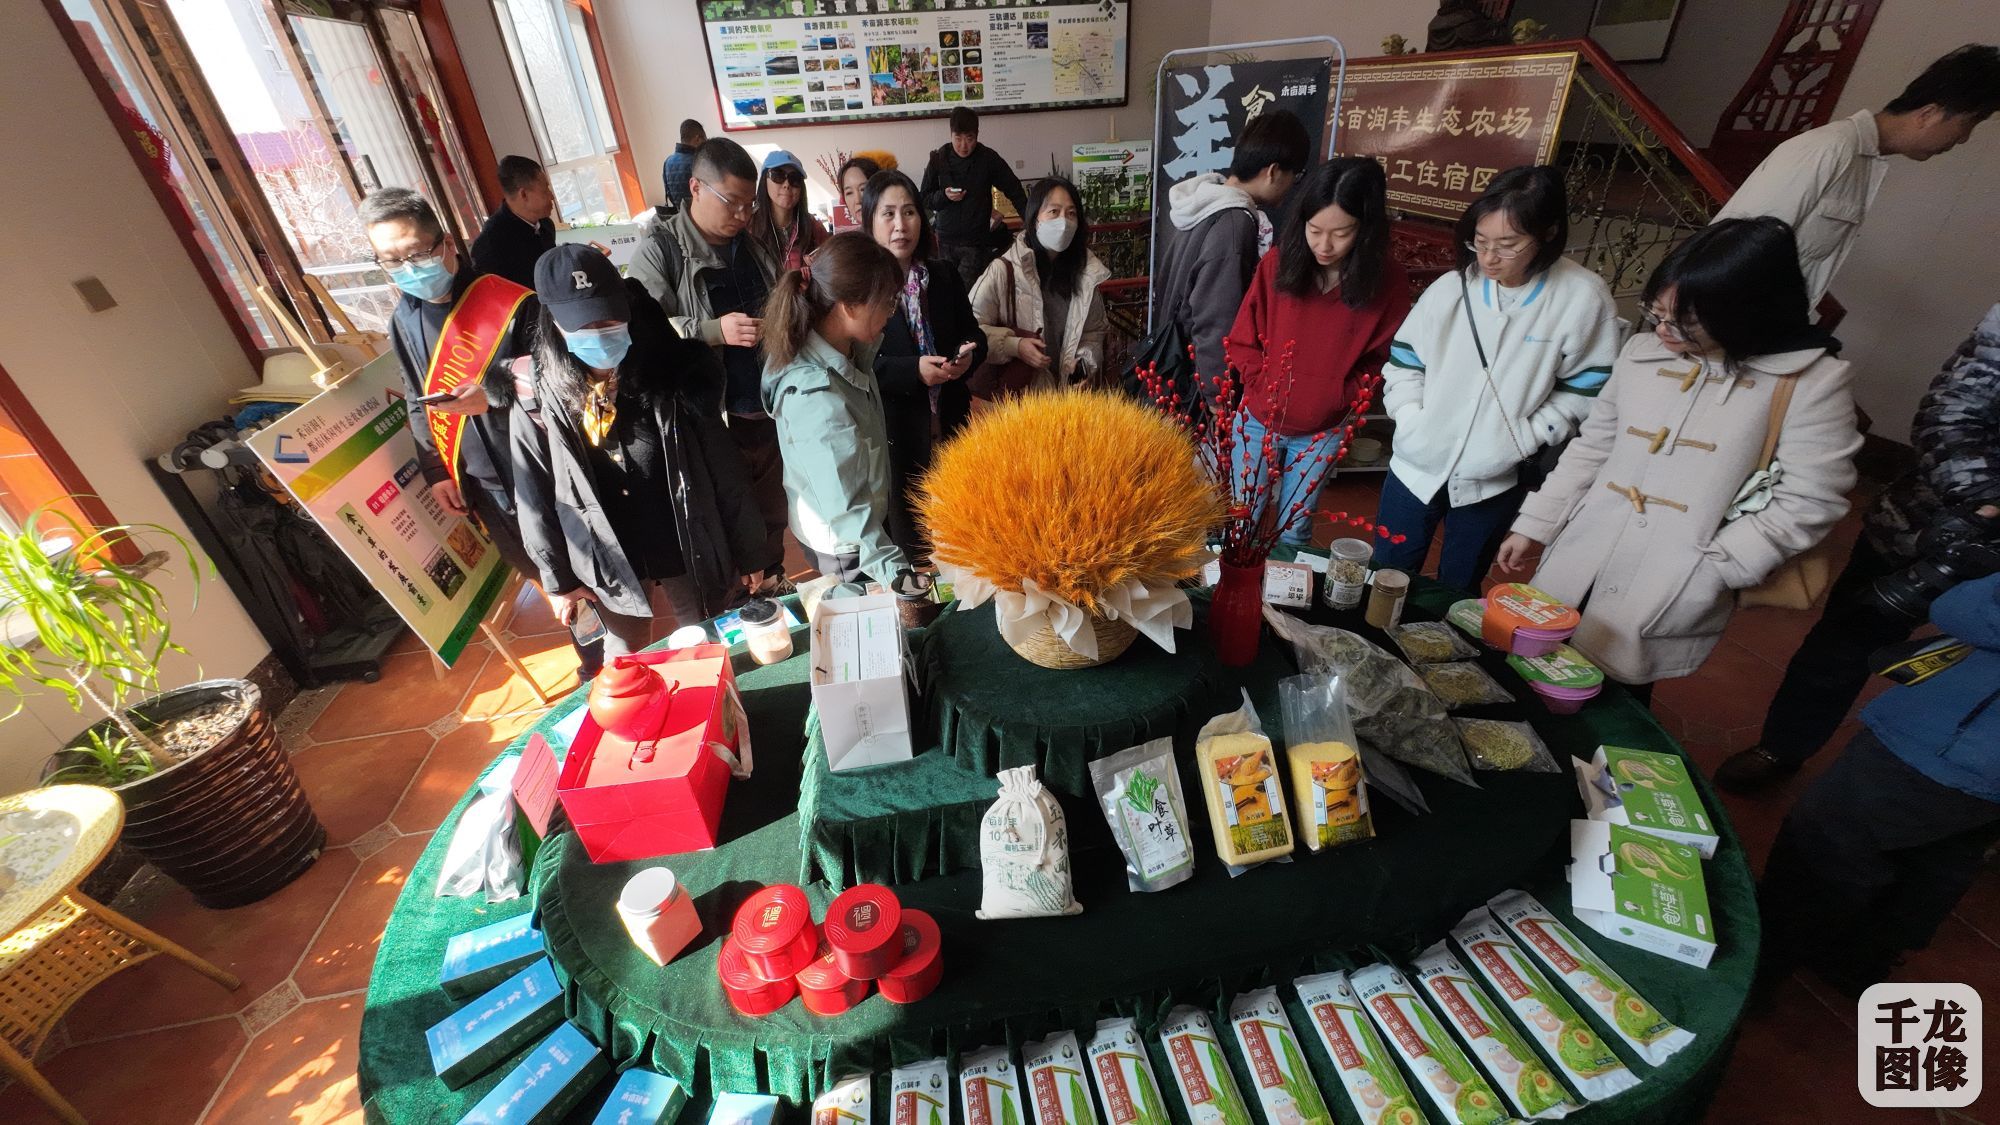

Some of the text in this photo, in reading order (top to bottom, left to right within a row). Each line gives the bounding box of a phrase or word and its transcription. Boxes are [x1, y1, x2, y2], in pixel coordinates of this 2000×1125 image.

[571, 270, 593, 290] R
[1148, 798, 1178, 844] 食叶草
[1375, 999, 1420, 1056] 食叶草挂面
[1432, 979, 1483, 1035] 食叶草挂面
[1243, 1023, 1273, 1085] 食叶草挂面
[1317, 1007, 1354, 1067] 食叶草挂面
[1099, 1057, 1127, 1121] 食叶草挂面
[1172, 1038, 1202, 1101] 食叶草挂面
[897, 1092, 909, 1125] 食叶
[966, 1080, 981, 1125] 食叶草
